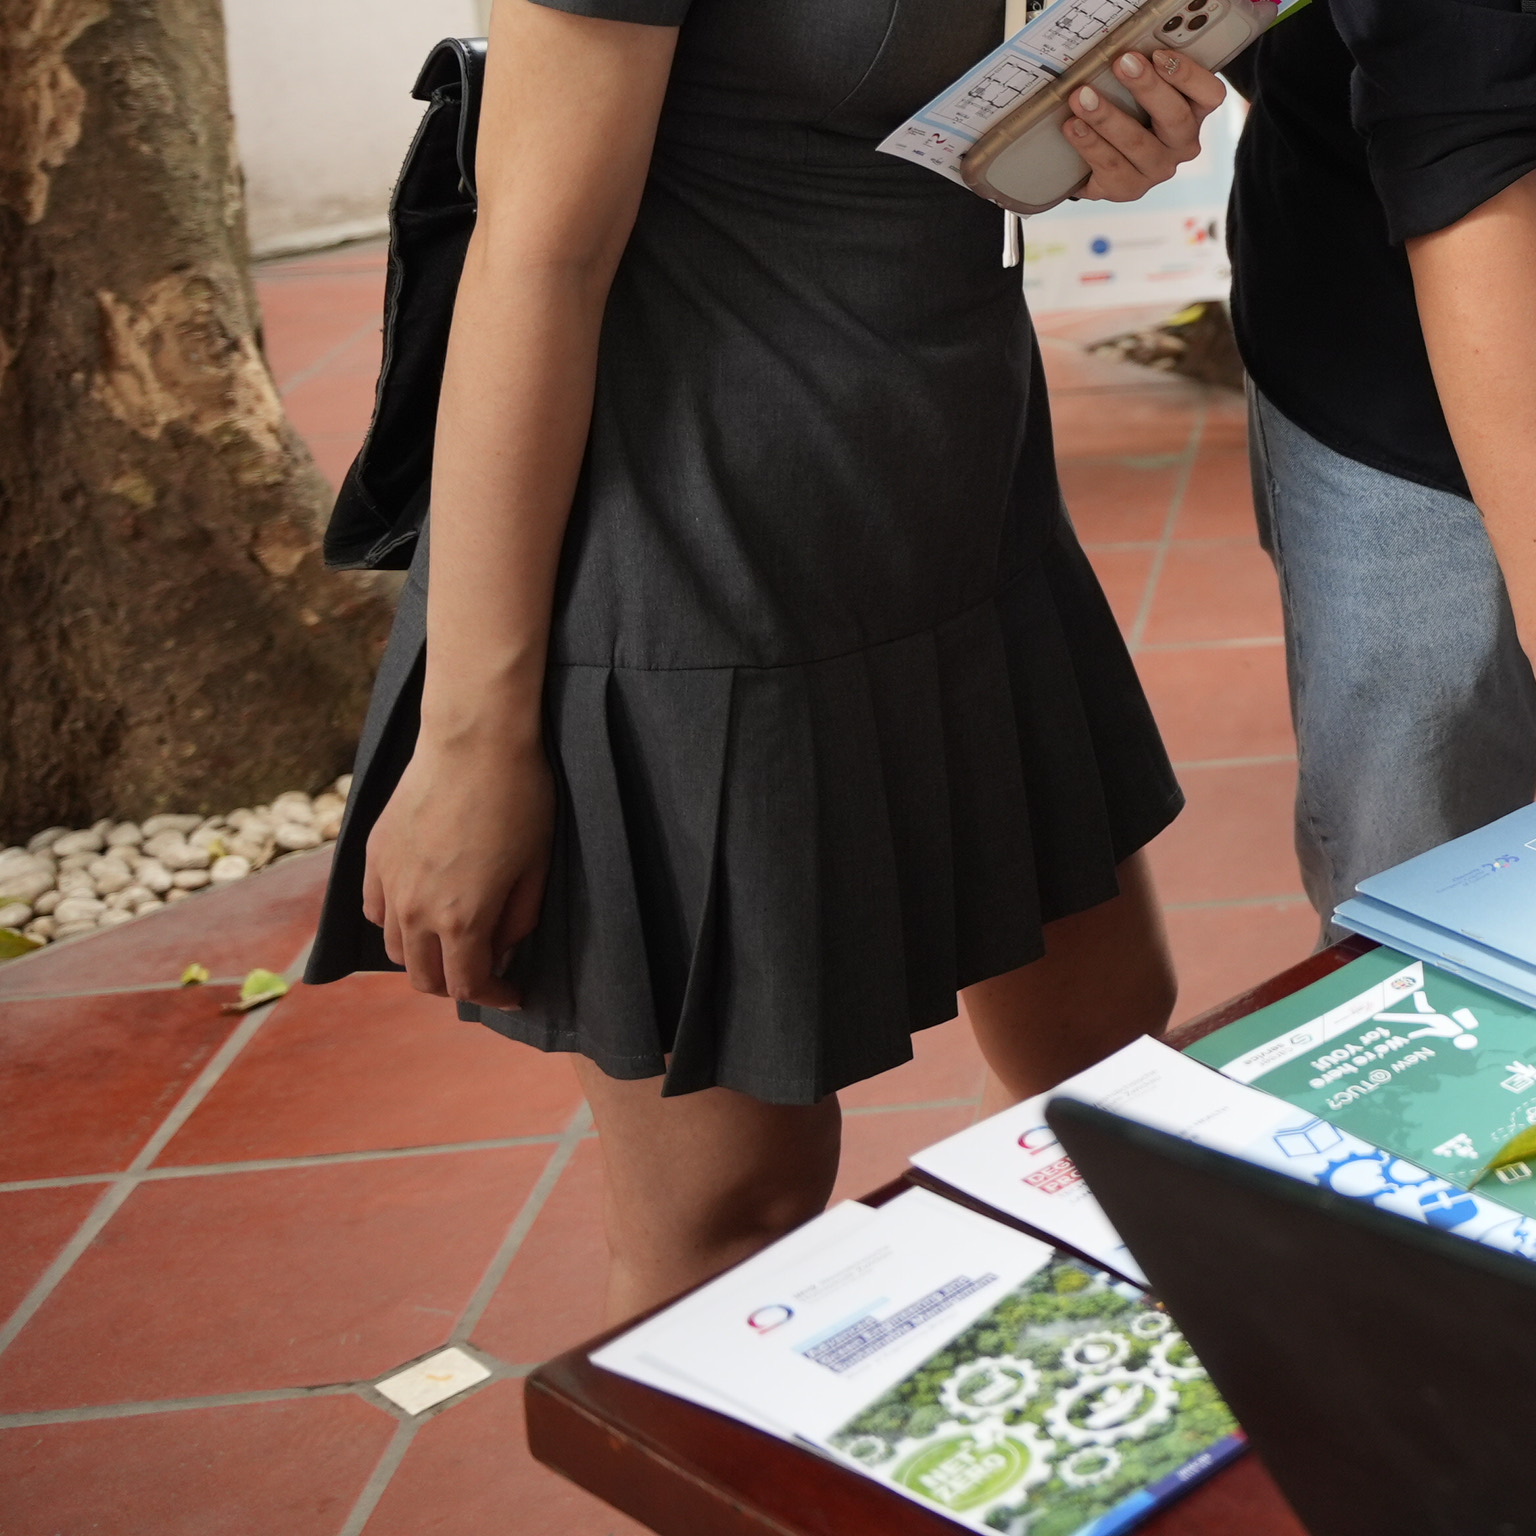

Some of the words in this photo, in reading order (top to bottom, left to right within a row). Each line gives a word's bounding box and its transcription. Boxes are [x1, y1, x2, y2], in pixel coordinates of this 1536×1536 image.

[1359, 1027, 1391, 1046] for
[1244, 1042, 1286, 1066] service
[1311, 1043, 1364, 1071] YOU!
[1352, 1035, 1410, 1068] We're
[1391, 1047, 1436, 1073] New
[1309, 1062, 1359, 1089] here
[1326, 1068, 1392, 1110] @TUC?
[920, 1450, 977, 1488] NET
[933, 1453, 1008, 1503] ZERO
